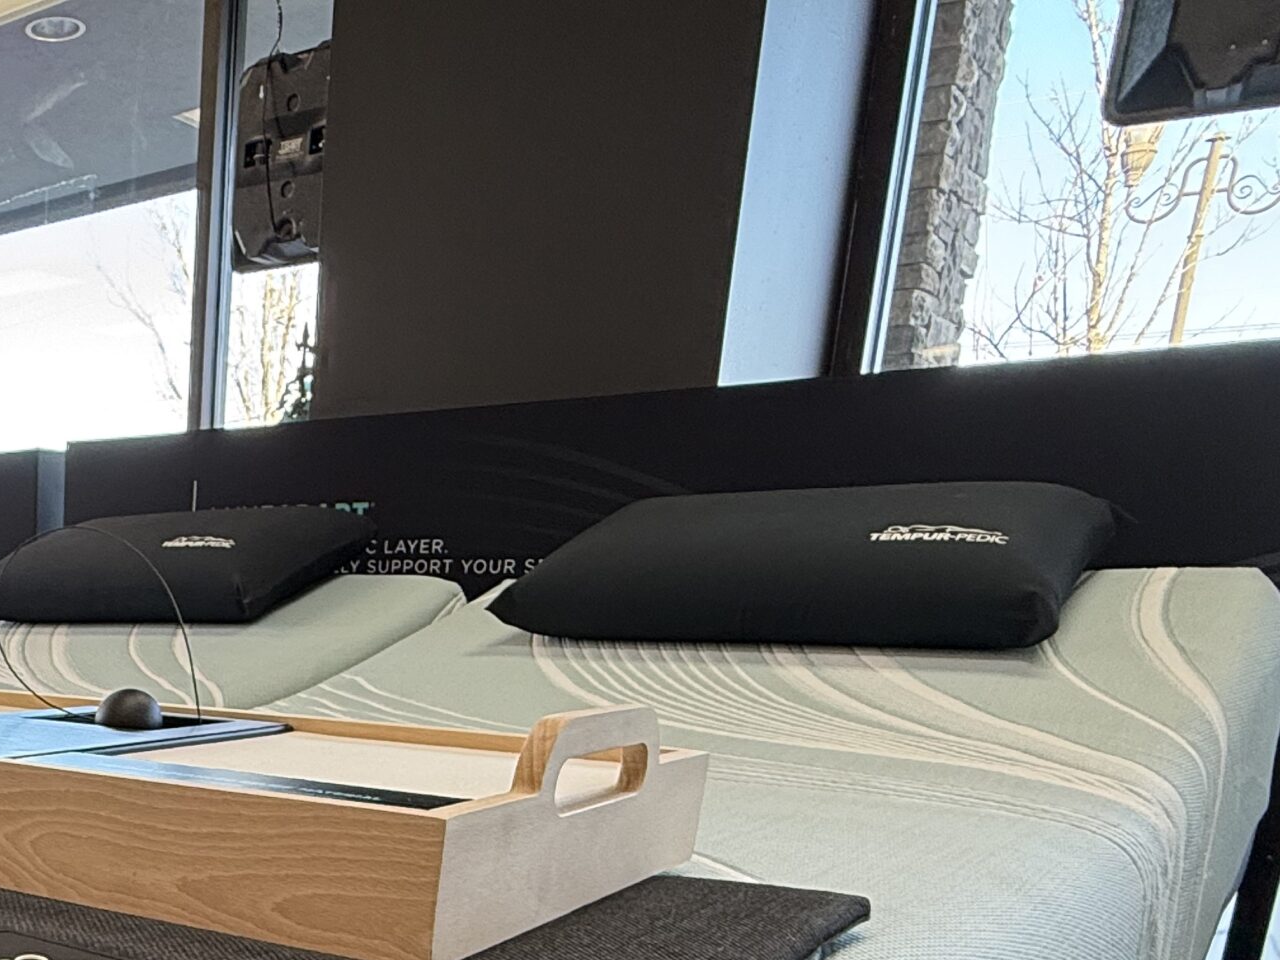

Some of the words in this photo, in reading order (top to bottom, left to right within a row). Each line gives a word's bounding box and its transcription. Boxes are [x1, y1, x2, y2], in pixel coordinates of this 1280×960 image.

[383, 538, 449, 555] LAYER.
[869, 532, 1010, 545] TEMPUR-PEDIC
[366, 559, 454, 574] SUPPORT
[461, 558, 516, 575] YOUR
